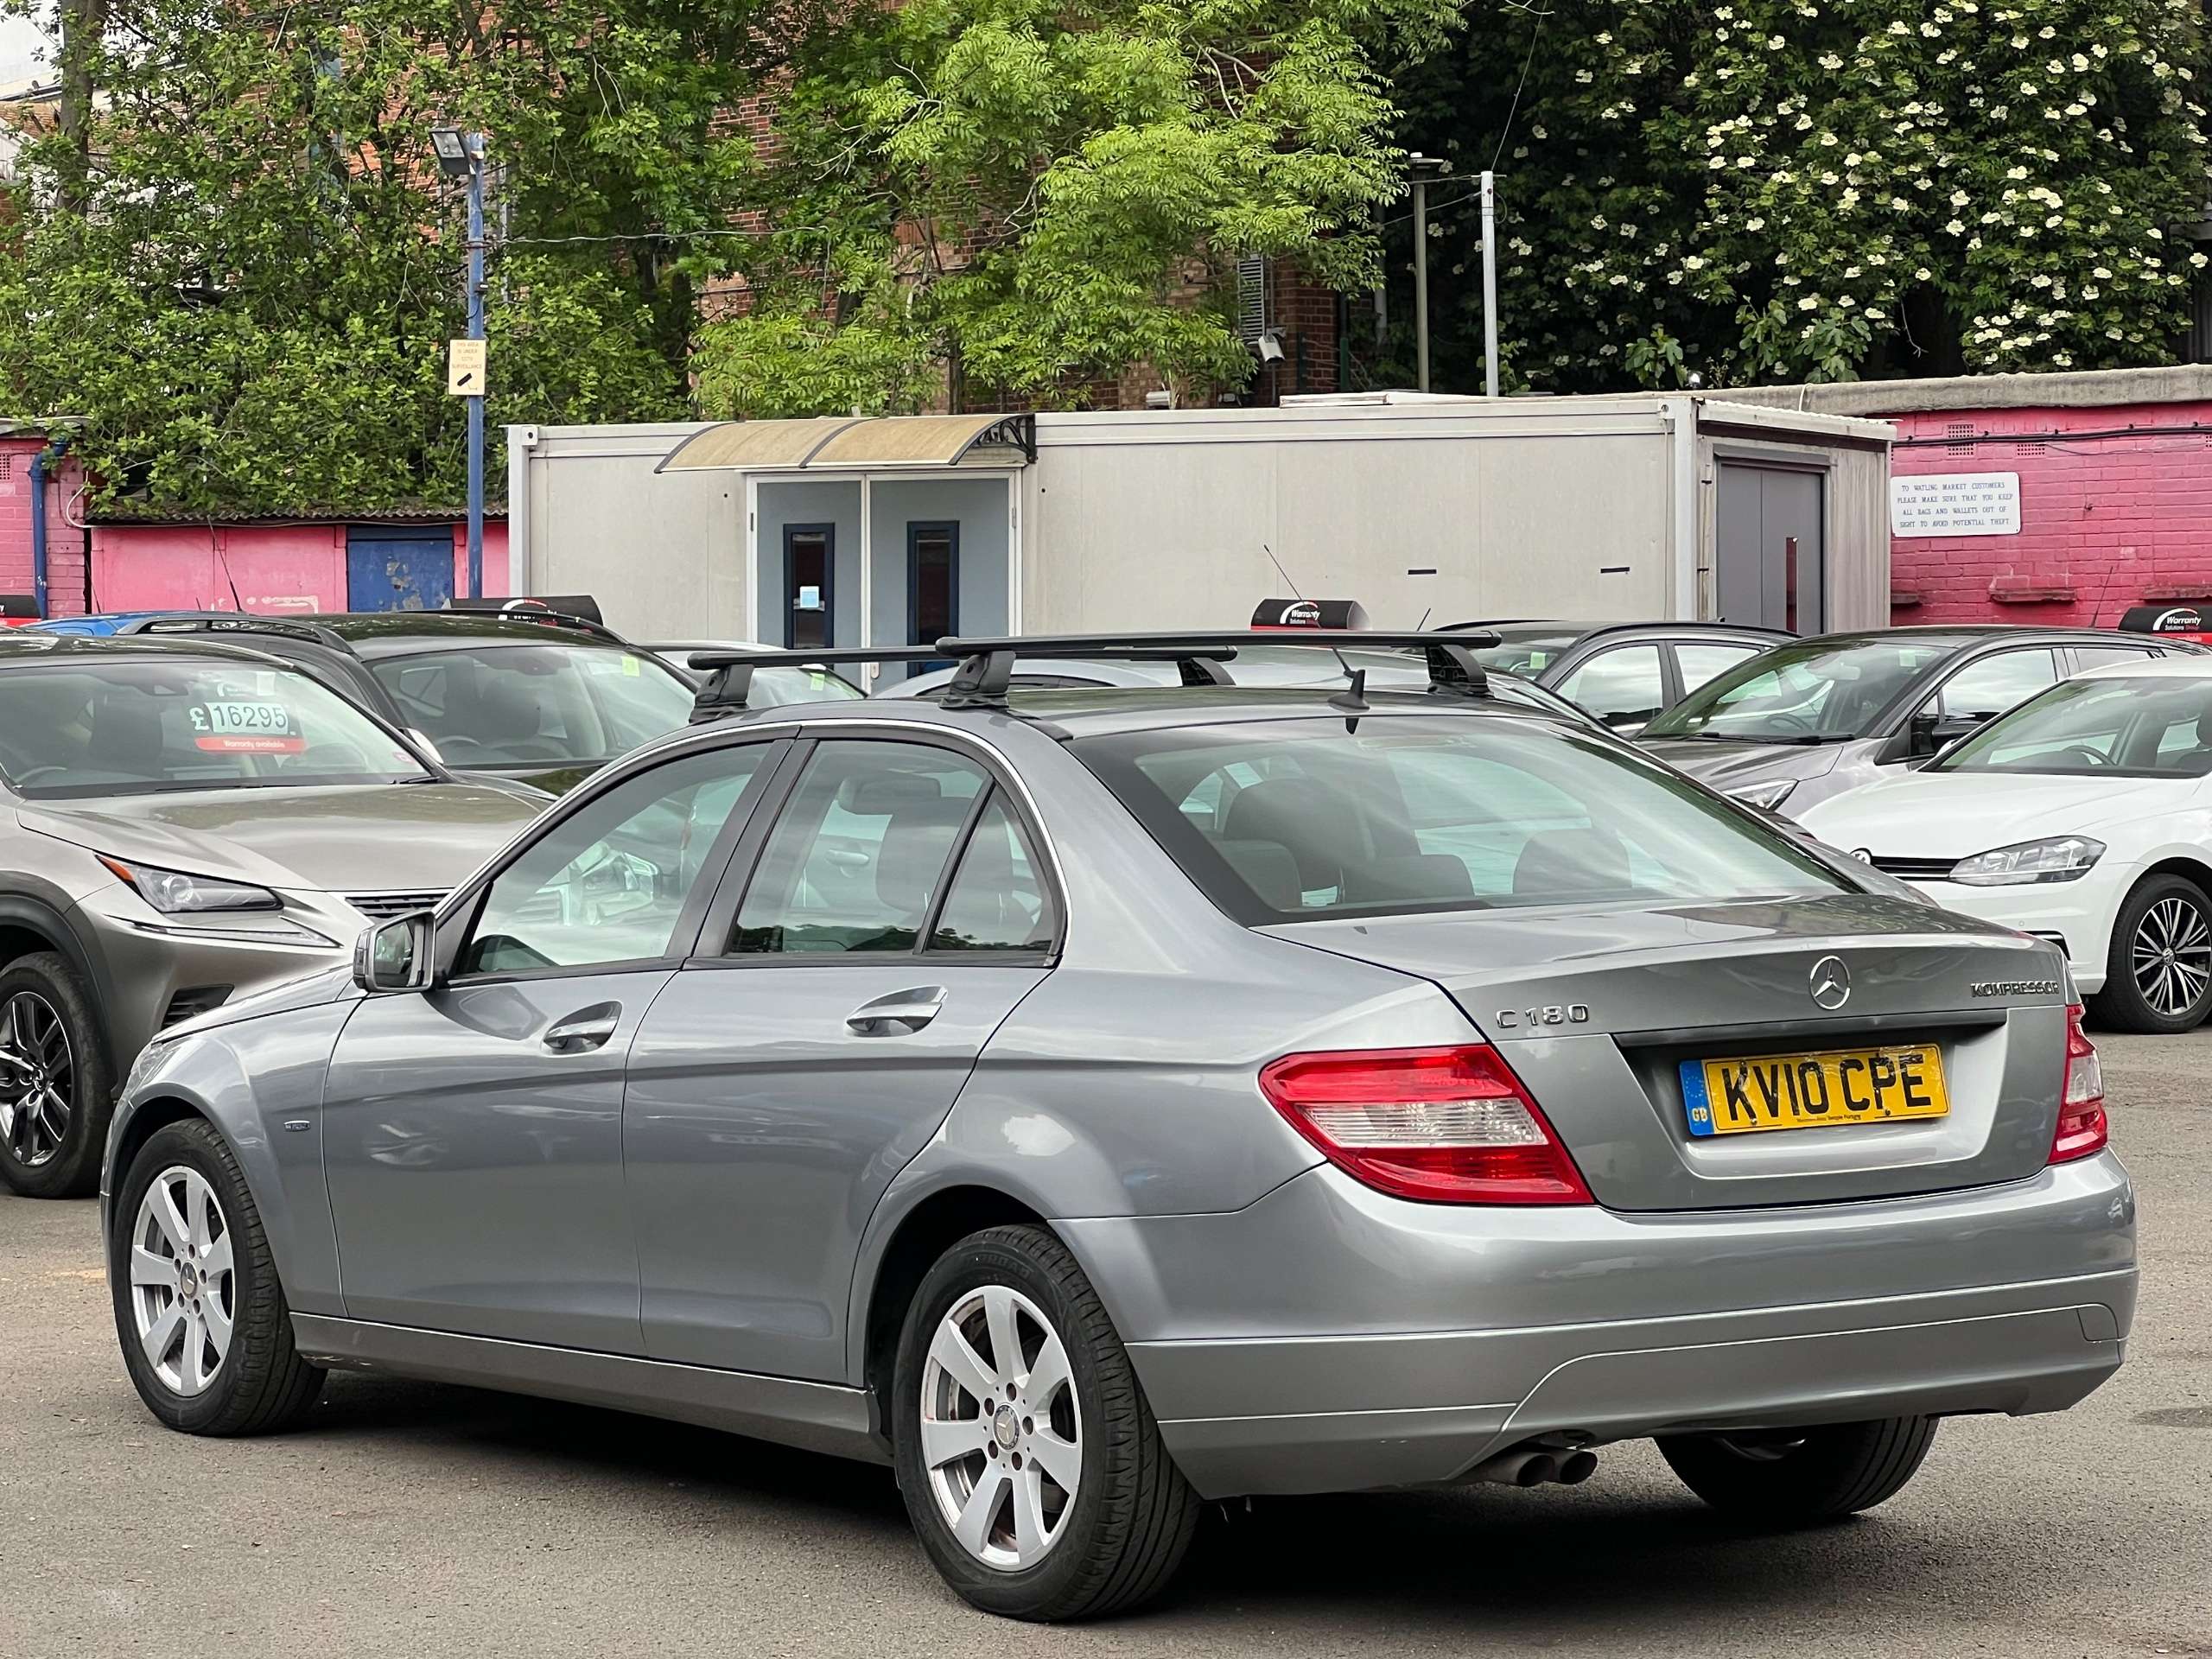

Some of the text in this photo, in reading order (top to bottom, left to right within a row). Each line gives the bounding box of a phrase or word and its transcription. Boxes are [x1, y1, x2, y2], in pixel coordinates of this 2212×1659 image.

[1291, 610, 1320, 620] Warranty
[2167, 616, 2201, 626] Warranty
[223, 739, 286, 749] Warranty available
[1970, 980, 2060, 998] KOMPRESSOR
[1496, 1004, 1589, 1029] C 180
[1721, 1053, 1933, 1122] KV10 CPE
[1691, 1106, 1707, 1122] GB
